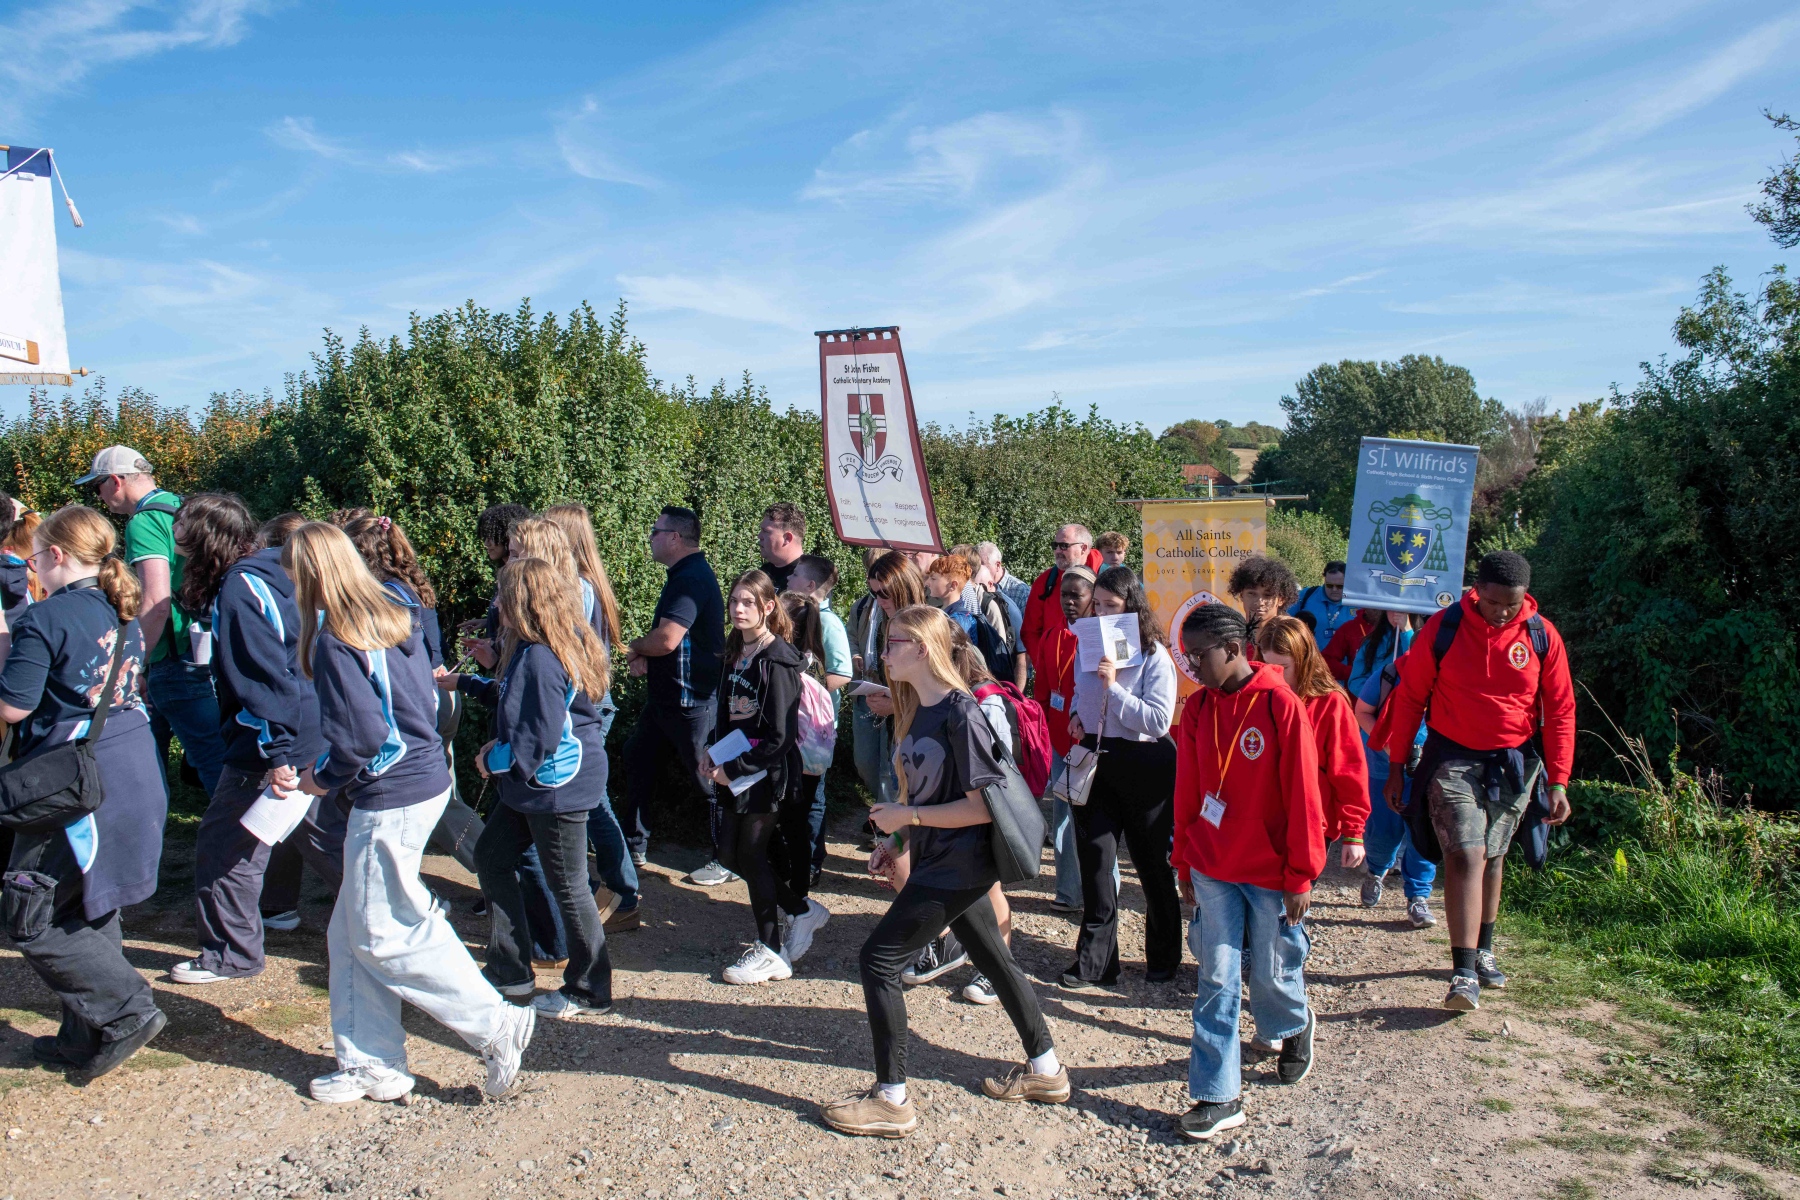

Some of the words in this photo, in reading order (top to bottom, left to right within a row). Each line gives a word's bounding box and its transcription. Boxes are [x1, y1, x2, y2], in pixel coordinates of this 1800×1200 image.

[844, 364, 850, 373] St
[862, 363, 880, 373] Fisher
[833, 376, 851, 384] Catholic
[872, 376, 891, 385] Academy
[1394, 452, 1468, 474] Wilfrid's
[894, 502, 918, 511] Respect
[841, 513, 859, 522] Honesty
[894, 518, 927, 527] Forgiveness
[1176, 529, 1193, 541] All
[1196, 529, 1232, 540] Saints
[1156, 546, 1205, 558] Catholic
[1208, 546, 1253, 561] College
[1186, 597, 1200, 609] ALL
[1172, 648, 1186, 668] LOVE
